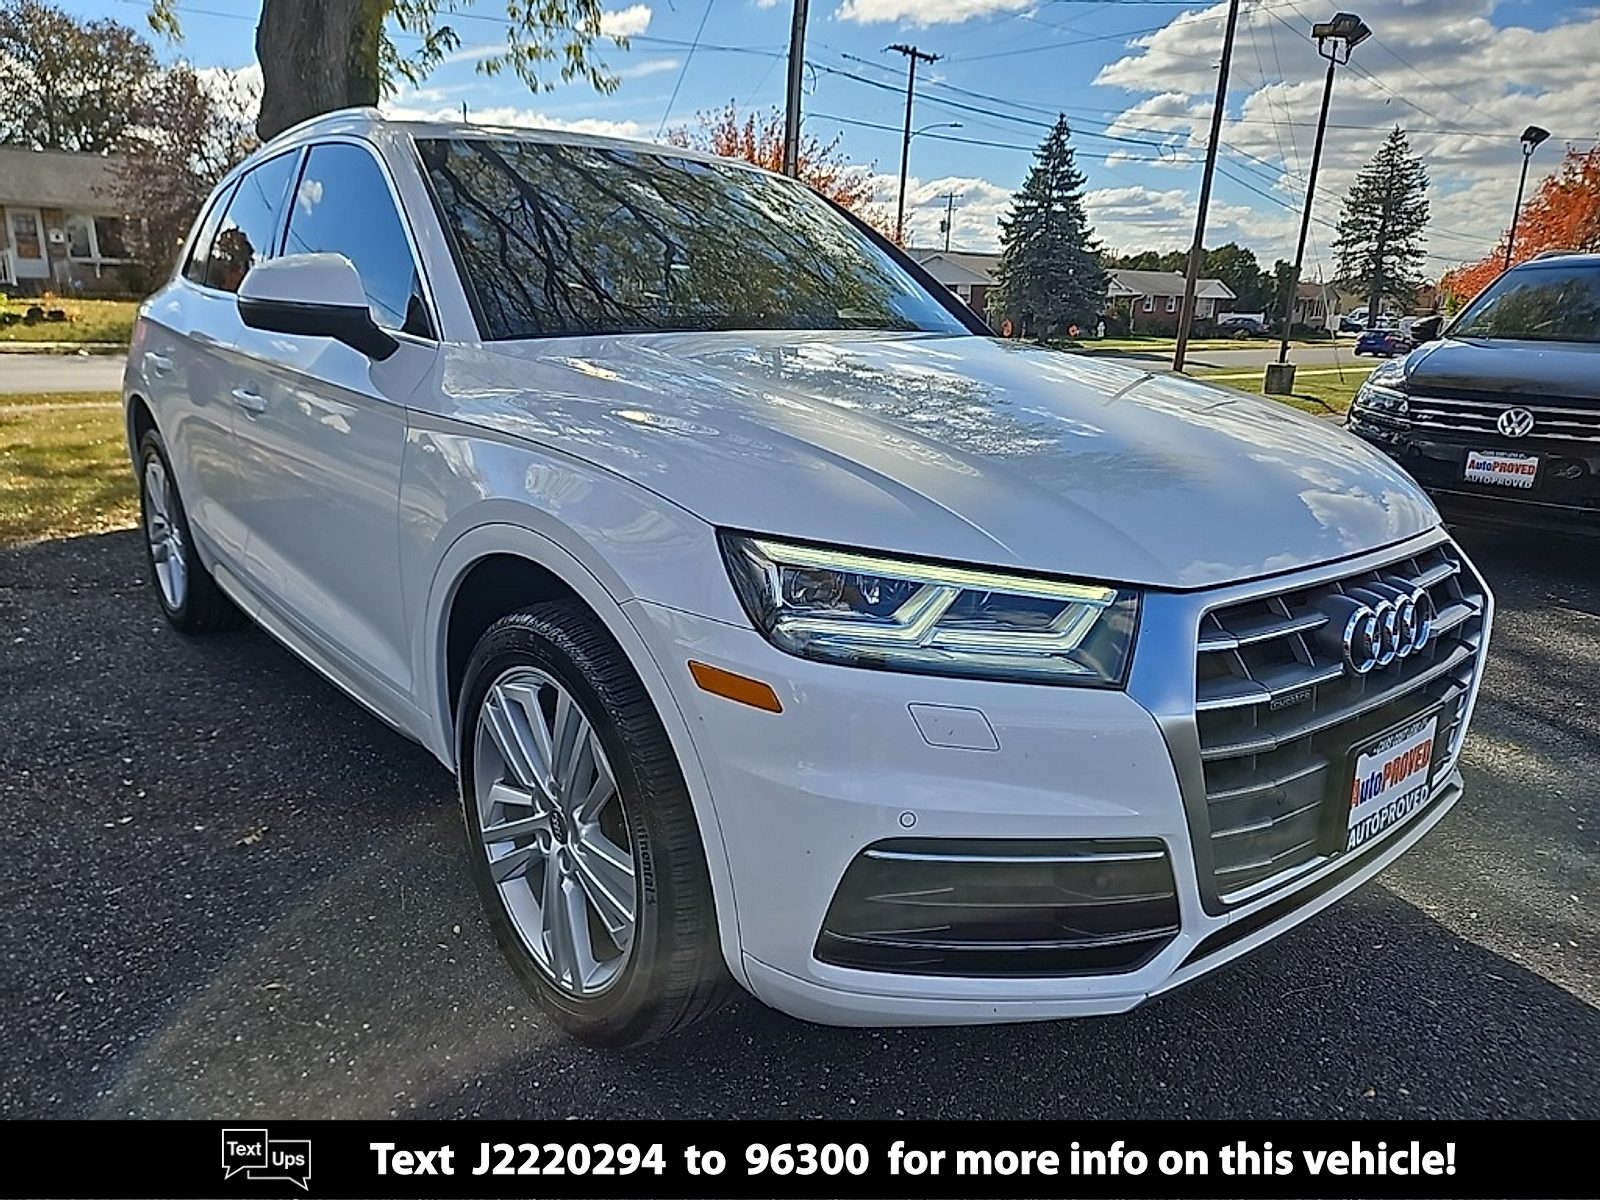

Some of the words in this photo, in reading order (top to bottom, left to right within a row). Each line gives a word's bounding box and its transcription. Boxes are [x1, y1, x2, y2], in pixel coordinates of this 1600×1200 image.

[1464, 474, 1533, 489] AUTOPROVED
[1468, 459, 1536, 476] AutoPROVED
[1351, 738, 1433, 808] AutoPROVED
[1348, 784, 1430, 848] AUTOPROVED
